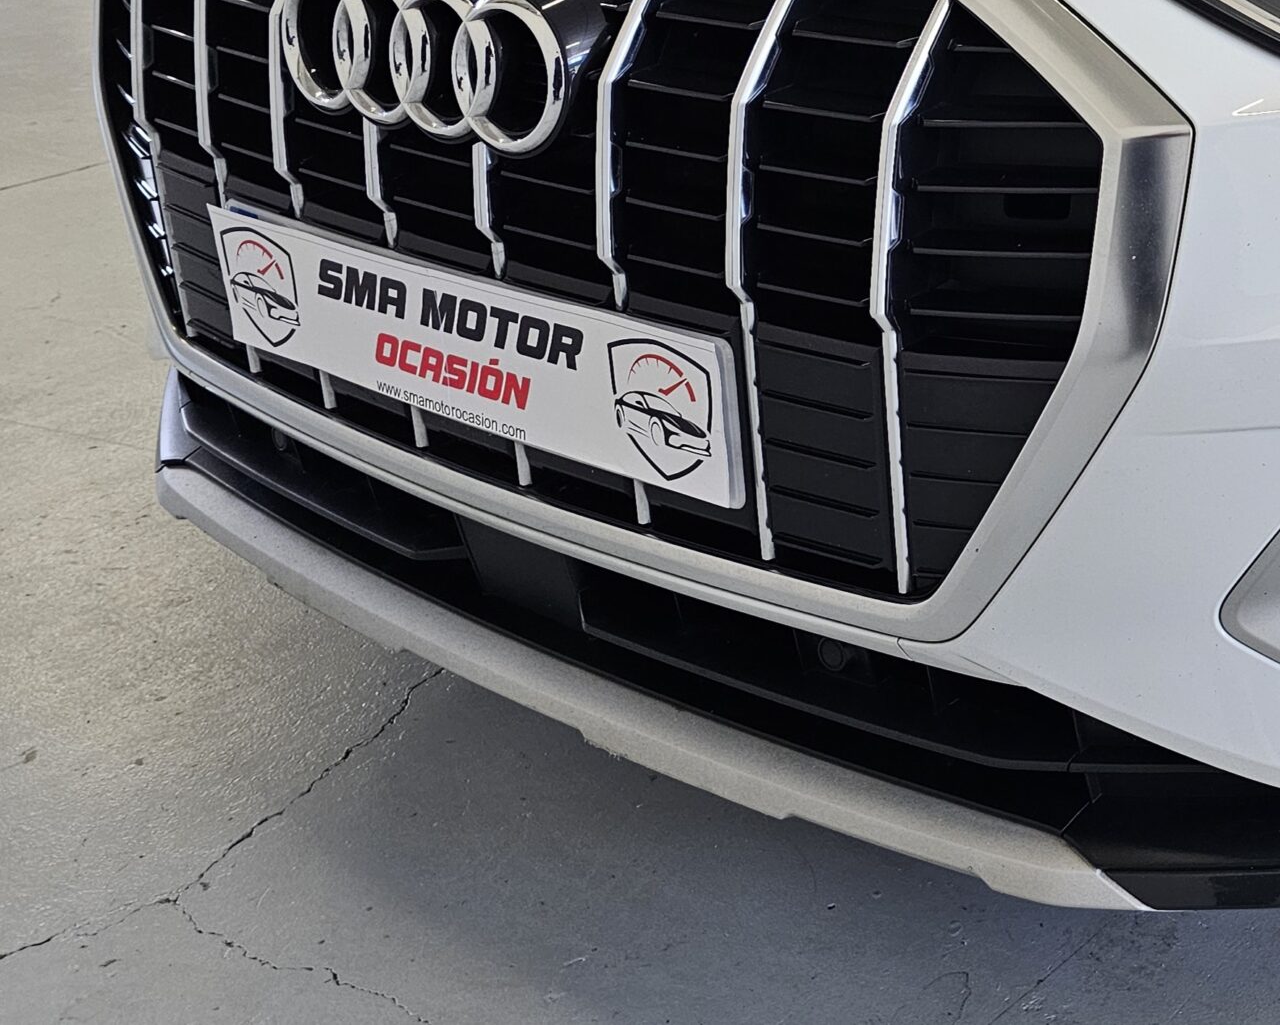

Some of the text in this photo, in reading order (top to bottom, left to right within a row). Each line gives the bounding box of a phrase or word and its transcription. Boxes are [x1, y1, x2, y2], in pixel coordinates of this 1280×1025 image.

[318, 259, 584, 371] SMA MOTOR
[375, 333, 531, 411] OCASIÓN
[377, 380, 526, 441] www.smamotorocasion.com
